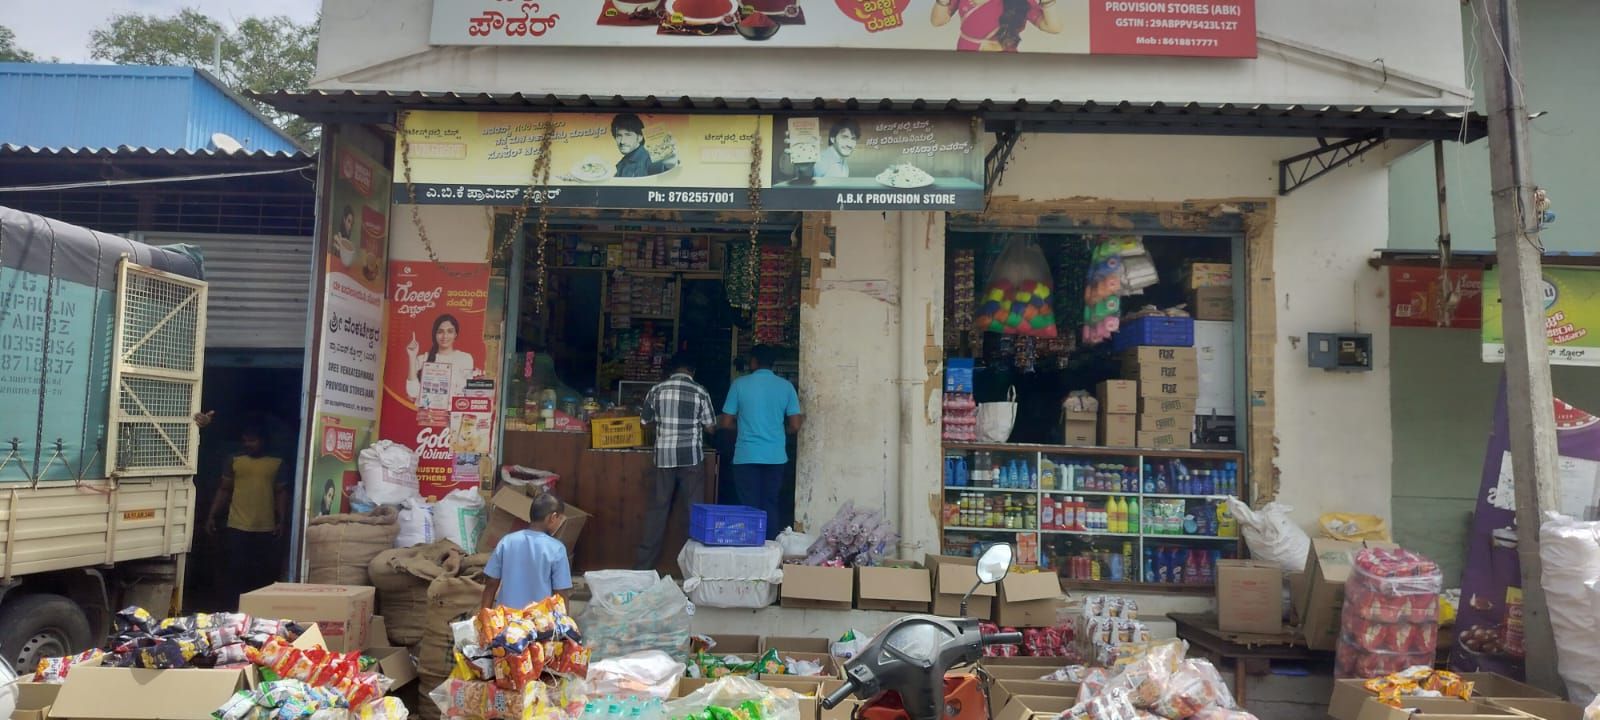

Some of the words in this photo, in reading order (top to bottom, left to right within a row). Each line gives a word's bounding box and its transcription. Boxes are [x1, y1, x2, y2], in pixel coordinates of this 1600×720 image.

[1105, 2, 1166, 14] PROVISION
[1167, 3, 1209, 15] STORES
[1211, 5, 1241, 17] (ABK)
[469, 11, 560, 37] ಪೌಡರ್
[1115, 18, 1144, 28] GSTIN
[1136, 36, 1156, 45] Mob
[1163, 38, 1219, 47] 8618817771
[466, 187, 520, 201] ಪ್ರಾವಿಜನ್
[647, 191, 666, 202] Ph:
[668, 192, 735, 203] 8762557001
[836, 193, 864, 204] A.B.K
[865, 193, 921, 205] PROVISION
[923, 193, 956, 205] STORE
